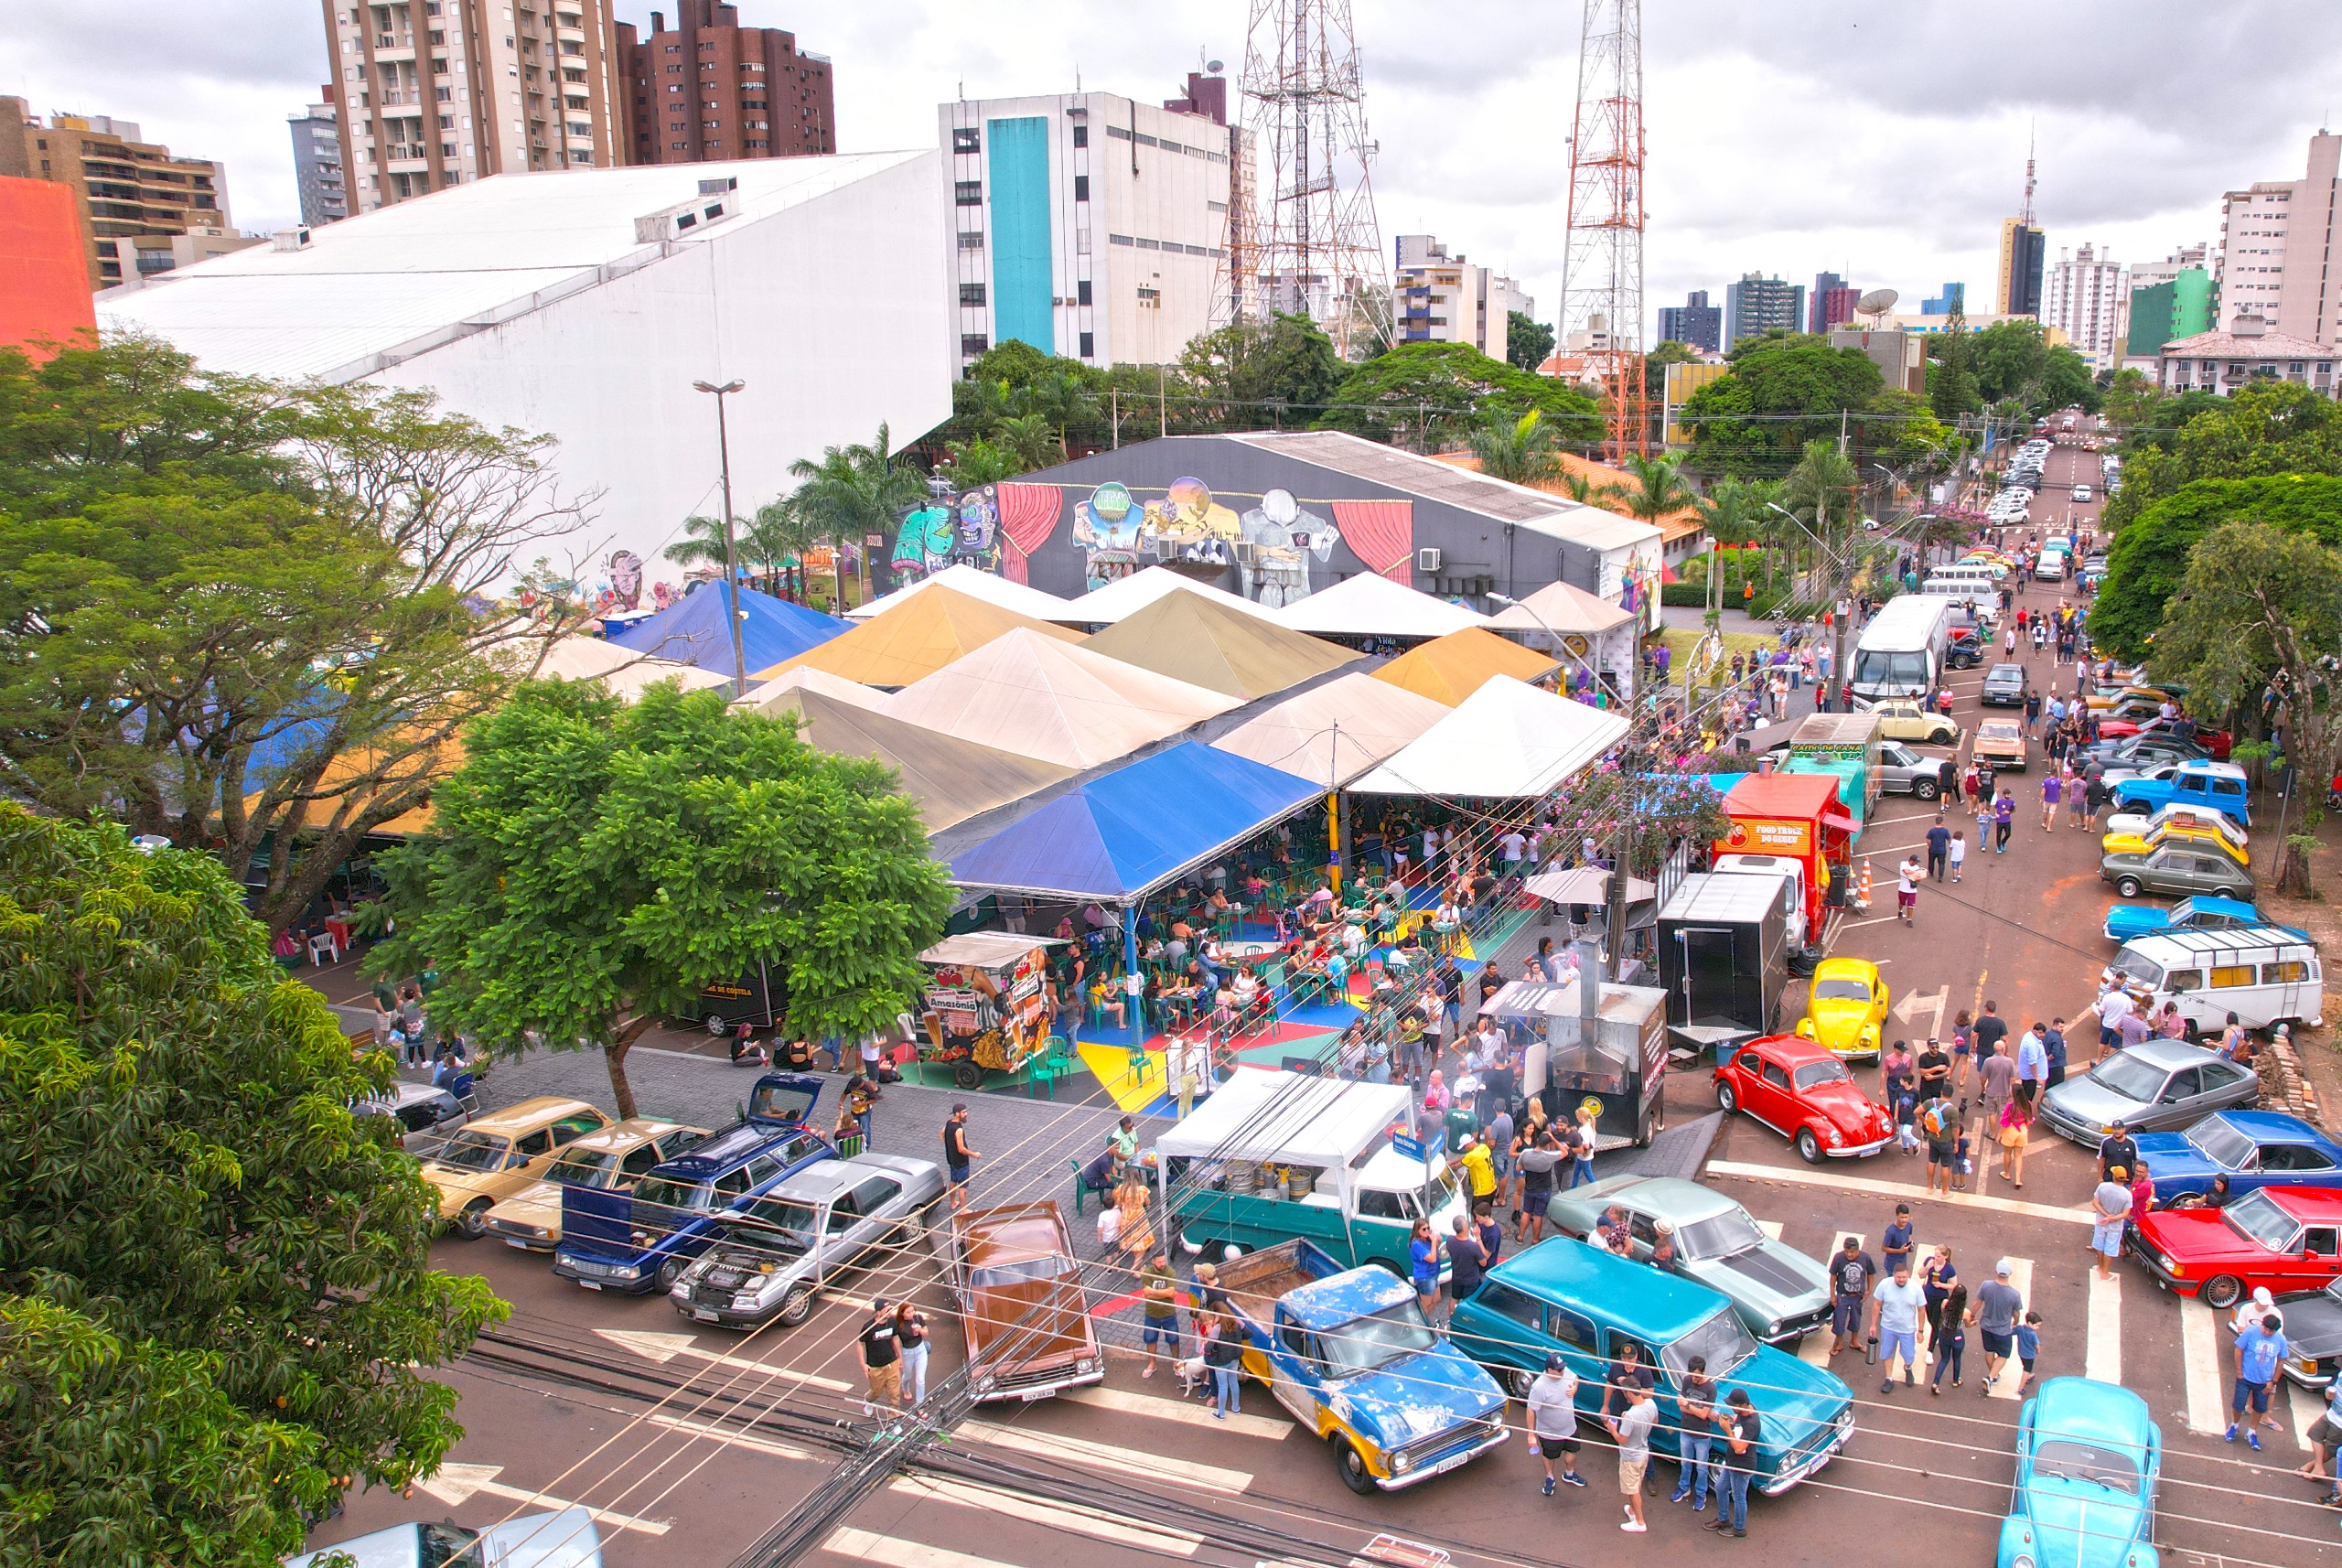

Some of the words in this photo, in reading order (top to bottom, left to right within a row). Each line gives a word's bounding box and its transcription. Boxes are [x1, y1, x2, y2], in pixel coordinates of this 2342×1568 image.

[1756, 825, 1777, 833] FOOD
[1778, 826, 1803, 835] TRUCK
[725, 987, 752, 996] COSTELA
